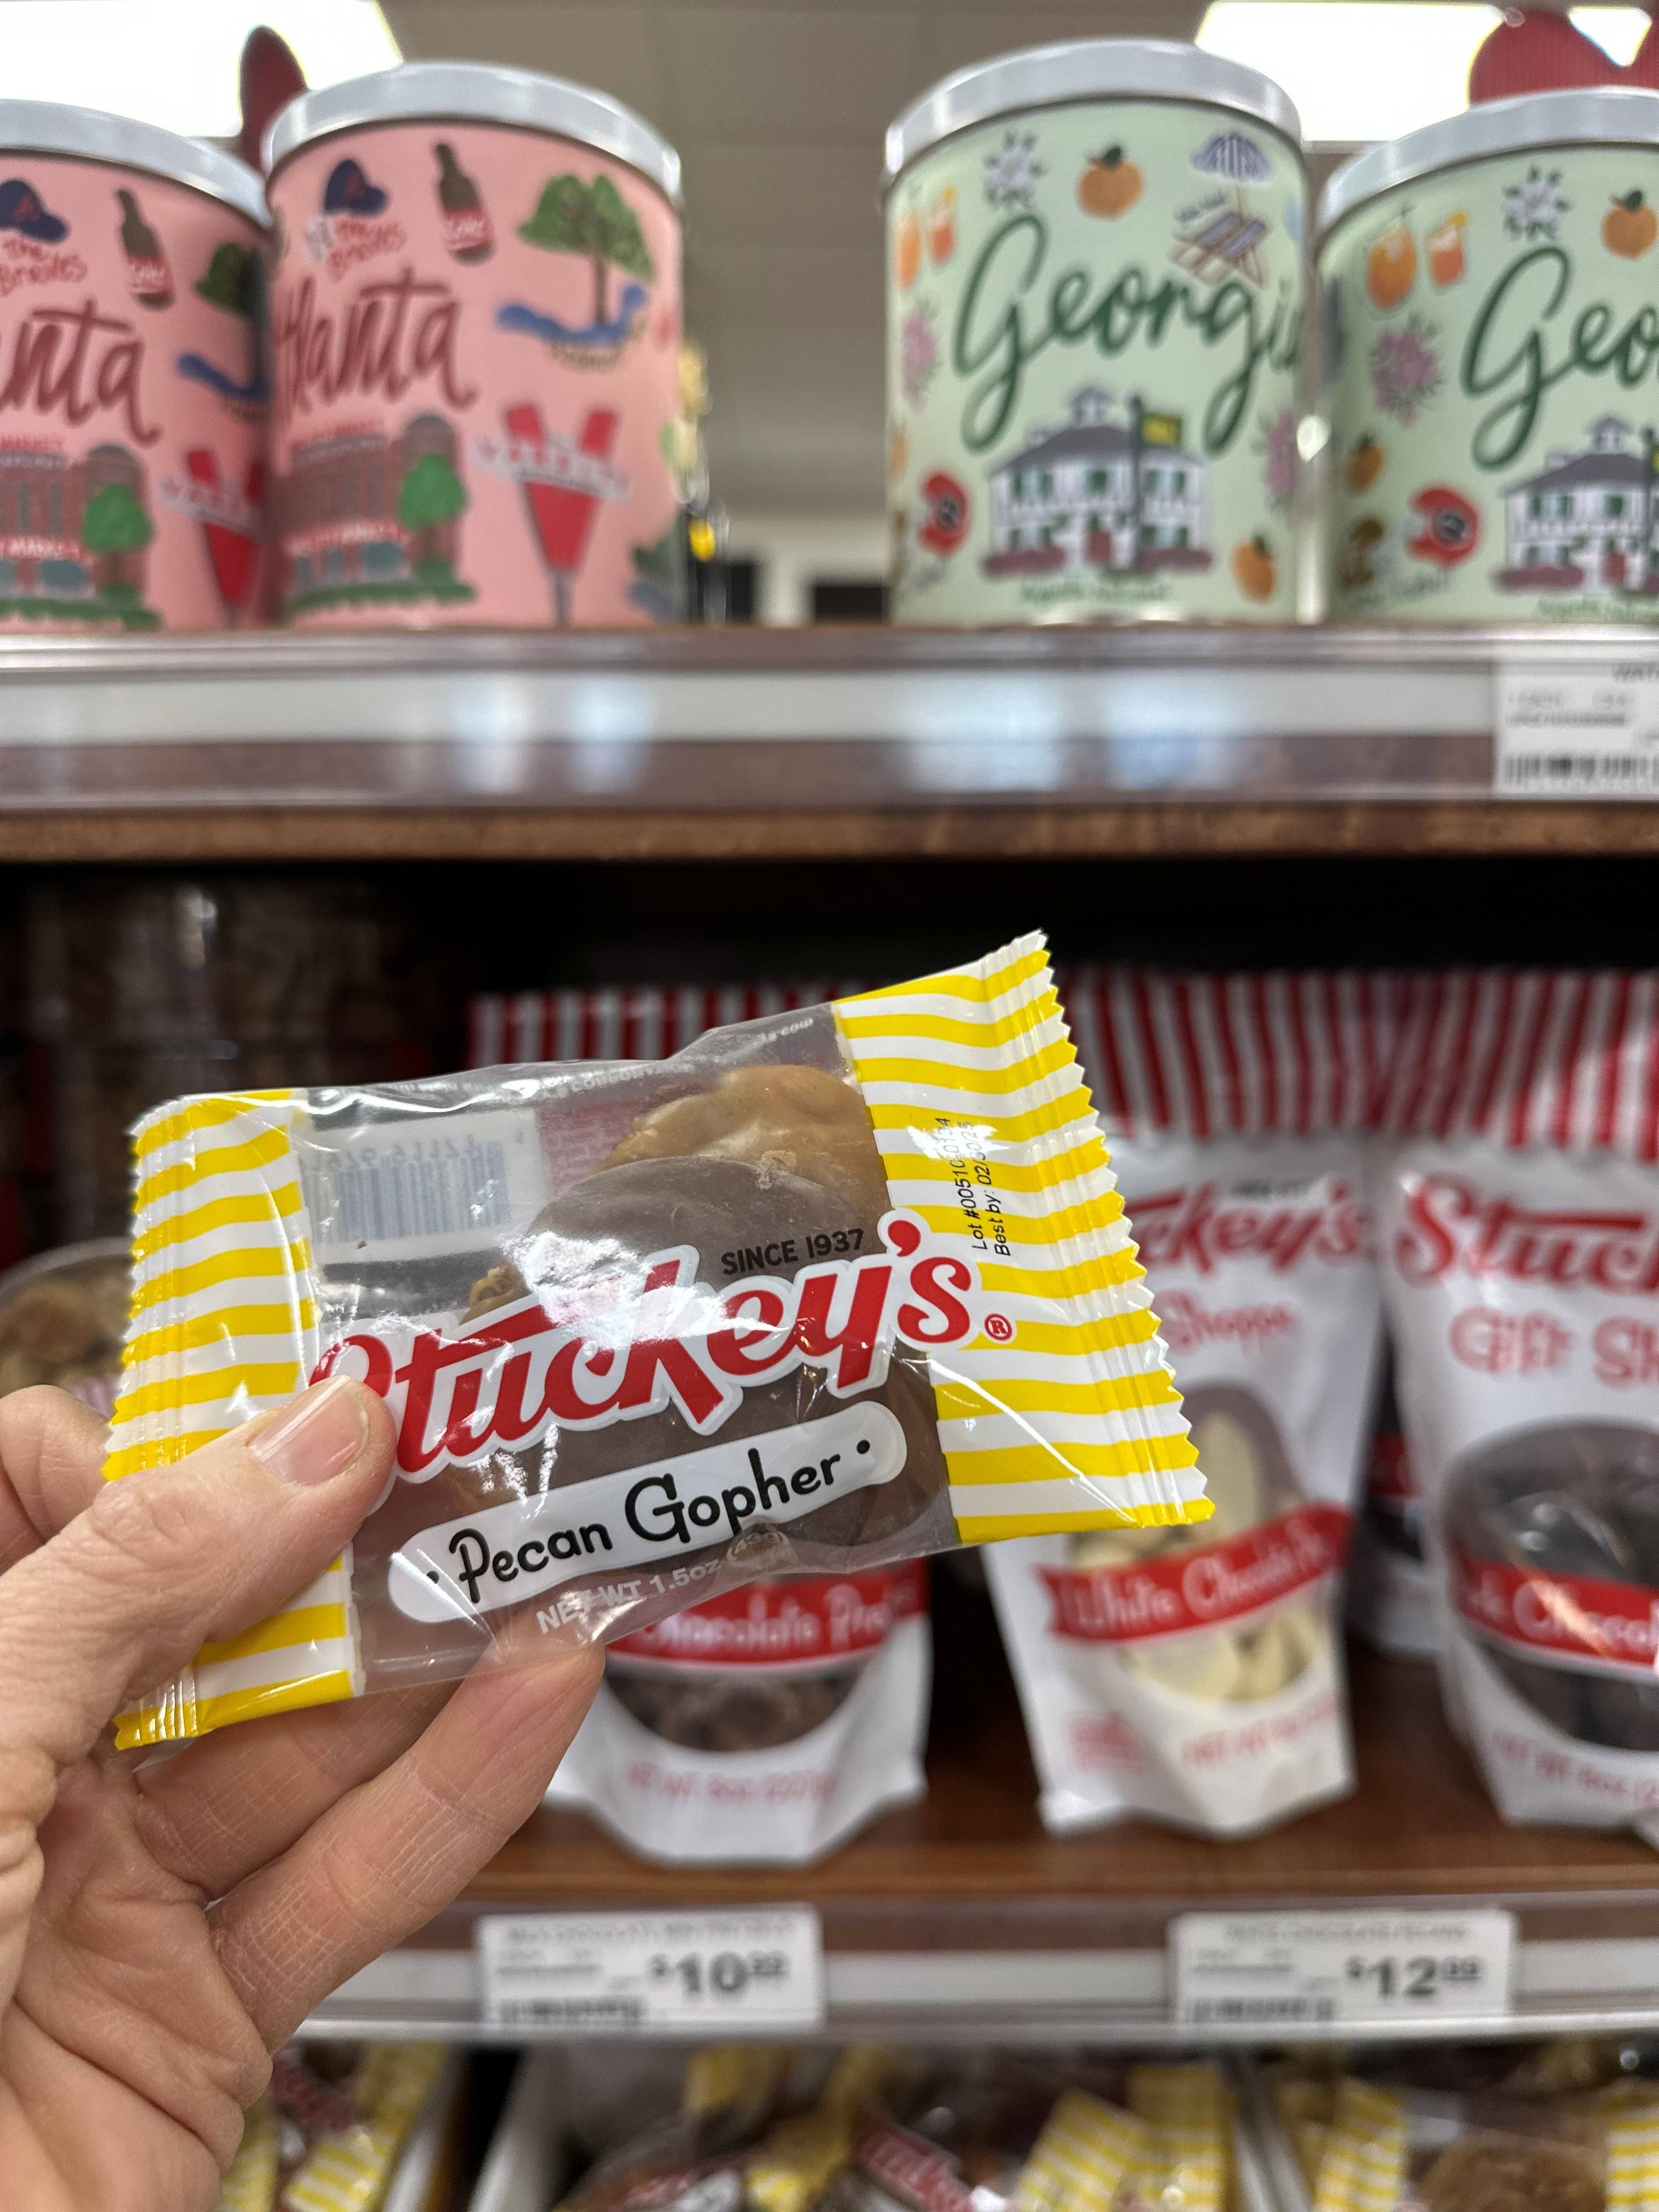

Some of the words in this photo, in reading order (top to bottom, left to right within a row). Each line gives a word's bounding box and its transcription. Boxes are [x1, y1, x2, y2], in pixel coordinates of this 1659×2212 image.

[0, 298, 162, 445] nta
[1460, 246, 1659, 471] Geo
[722, 1239, 795, 1276] SINCE
[806, 1228, 864, 1259] 1937
[968, 1224, 988, 1250] Lot
[989, 1218, 1011, 1256] Best
[1396, 1172, 1659, 1295] Stuc
[449, 1523, 613, 1604] Pecan
[624, 1447, 840, 1544] Gopher
[599, 1579, 641, 1607] WT
[650, 1559, 722, 1595] 1.5oz
